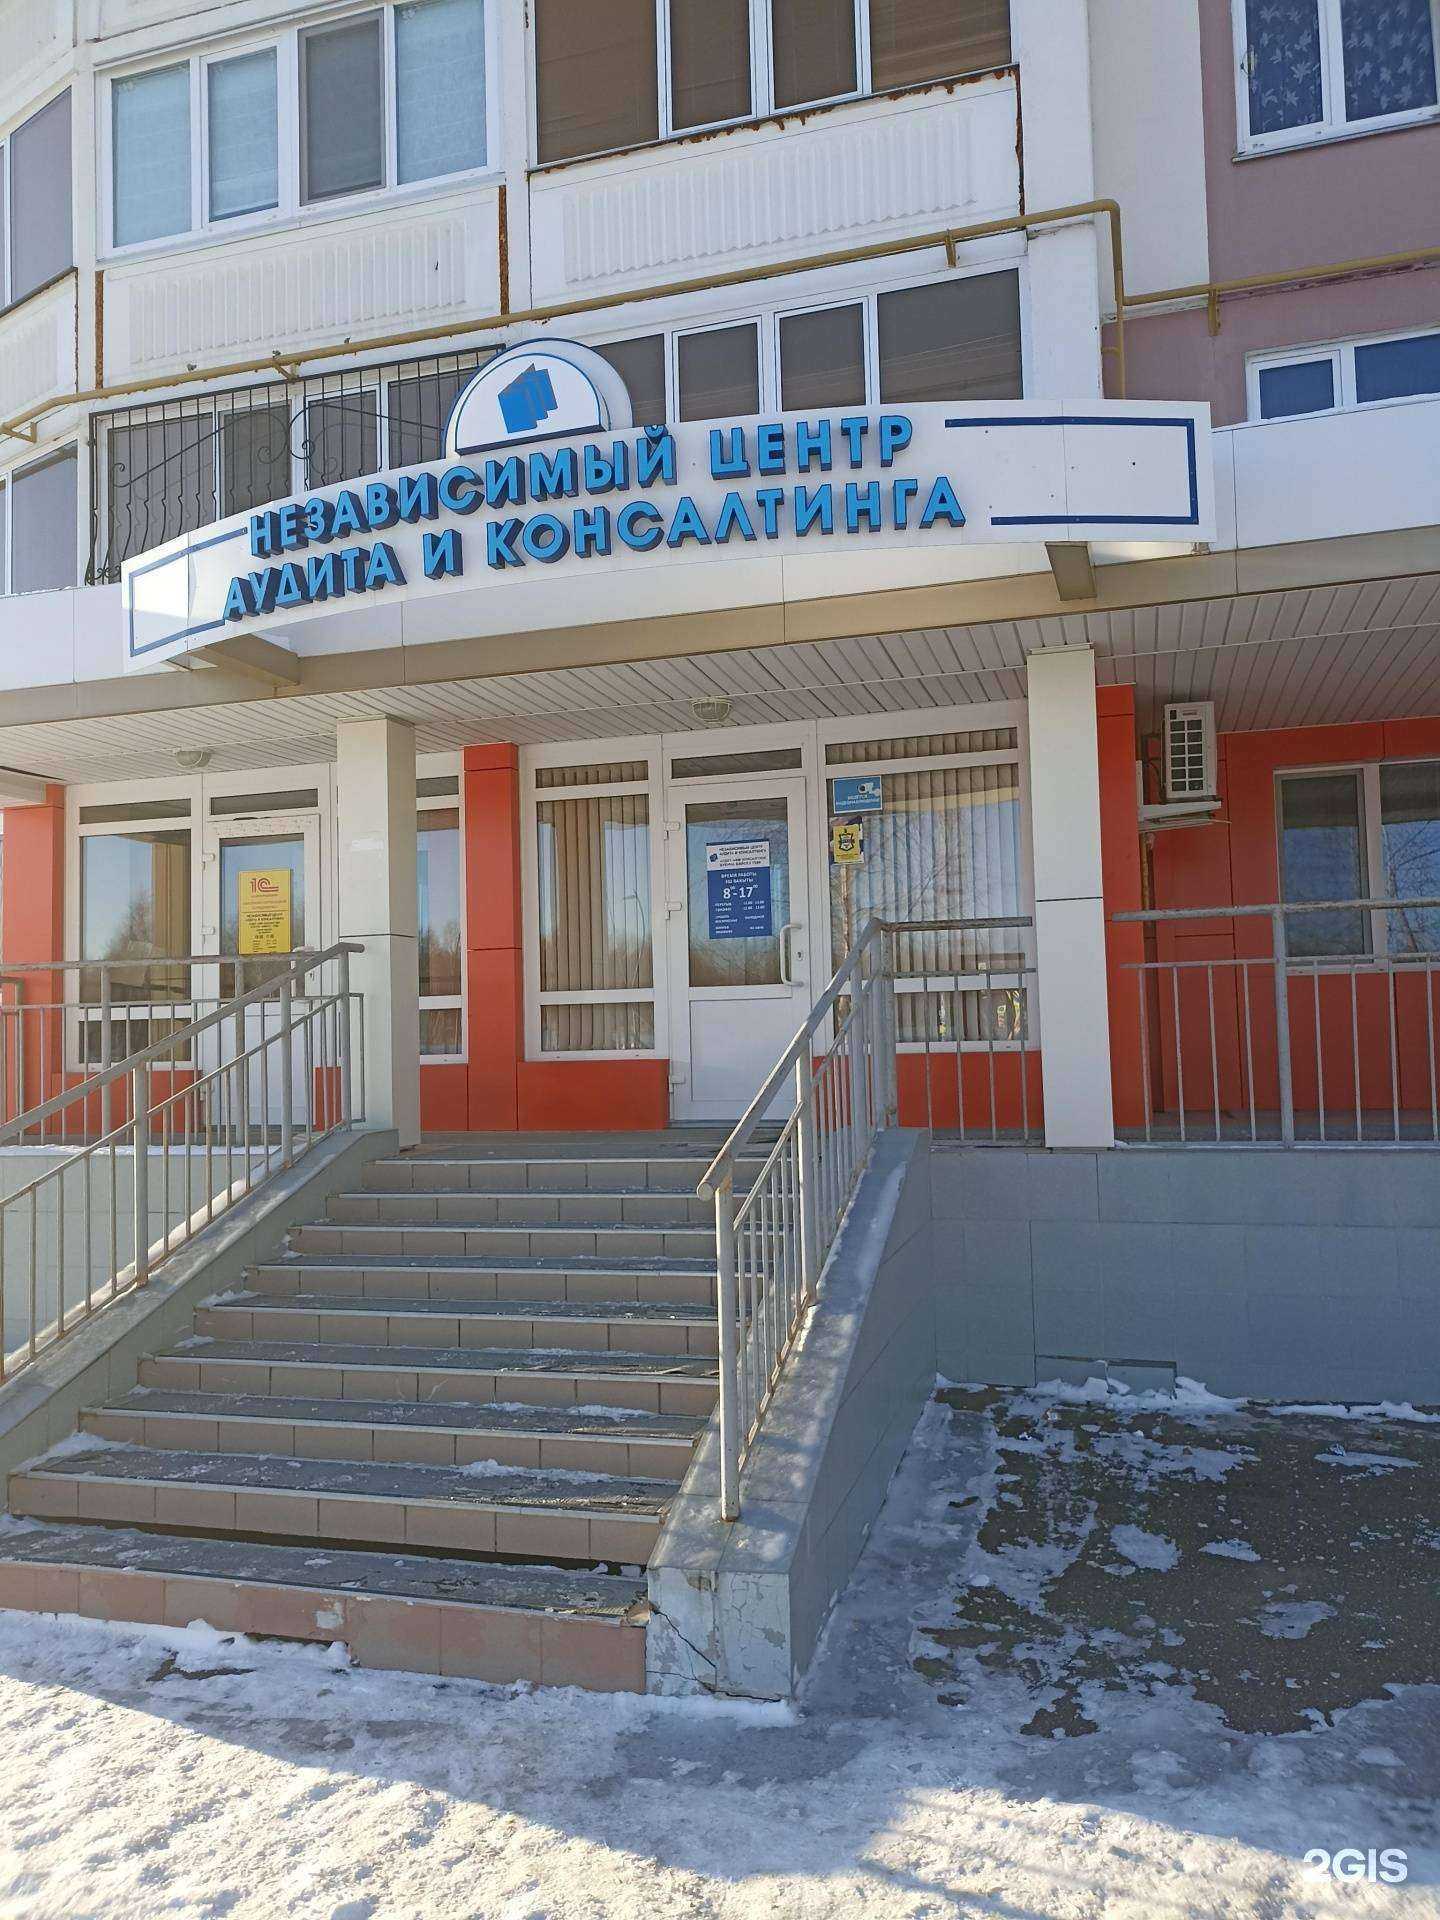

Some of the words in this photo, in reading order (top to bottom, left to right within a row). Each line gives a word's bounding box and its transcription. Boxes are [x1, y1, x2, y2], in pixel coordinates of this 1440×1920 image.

[222, 541, 407, 621] АУДИТА
[422, 528, 464, 580] И
[486, 476, 966, 570] КОНСАЛТИНГА
[250, 424, 677, 558] НЕЗАВИСИМЫЙ
[709, 415, 913, 480] ЦЕНТР
